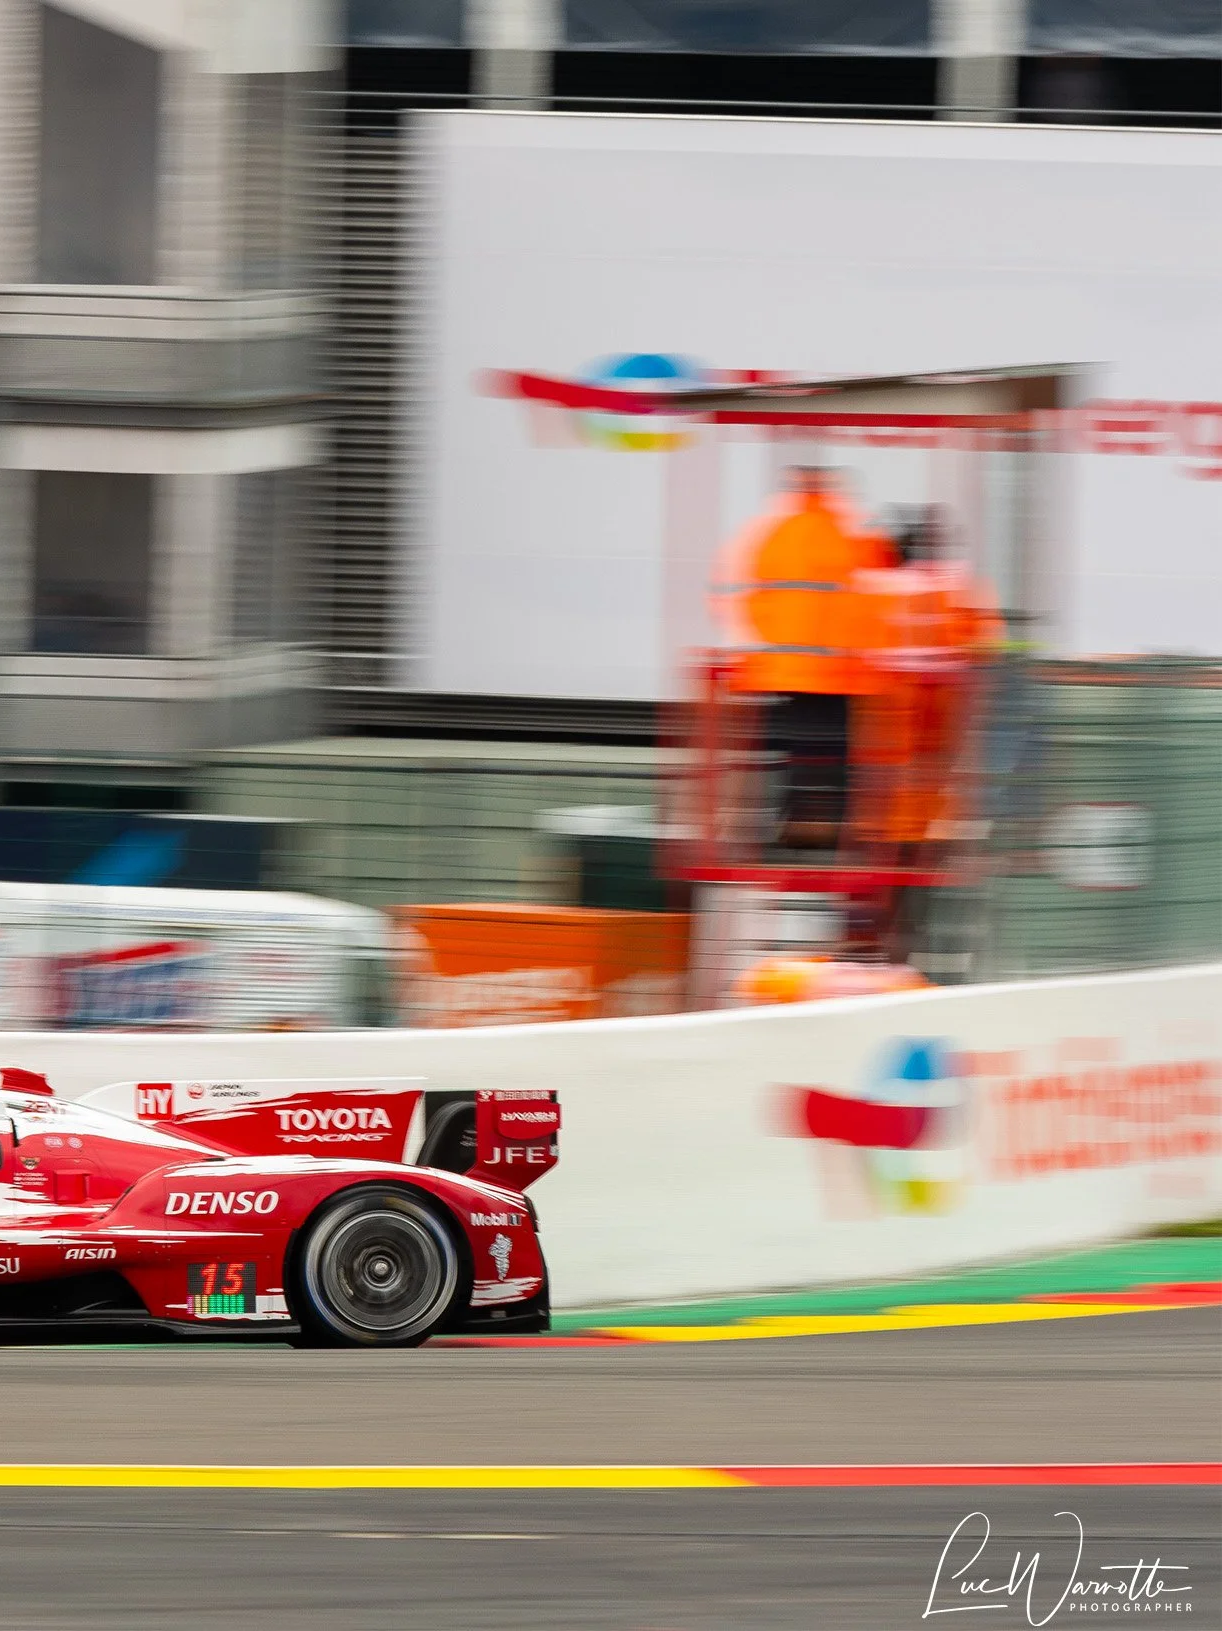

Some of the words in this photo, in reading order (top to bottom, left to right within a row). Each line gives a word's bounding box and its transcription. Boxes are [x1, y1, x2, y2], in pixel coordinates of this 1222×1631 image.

[137, 1089, 173, 1114] HY
[274, 1107, 393, 1130] TOYOTA
[275, 1132, 393, 1142] RACING
[483, 1146, 547, 1164] JFE
[164, 1190, 280, 1215] DENSO
[470, 1212, 509, 1226] Mobil
[64, 1248, 117, 1260] AISIN
[200, 1263, 245, 1295] 15
